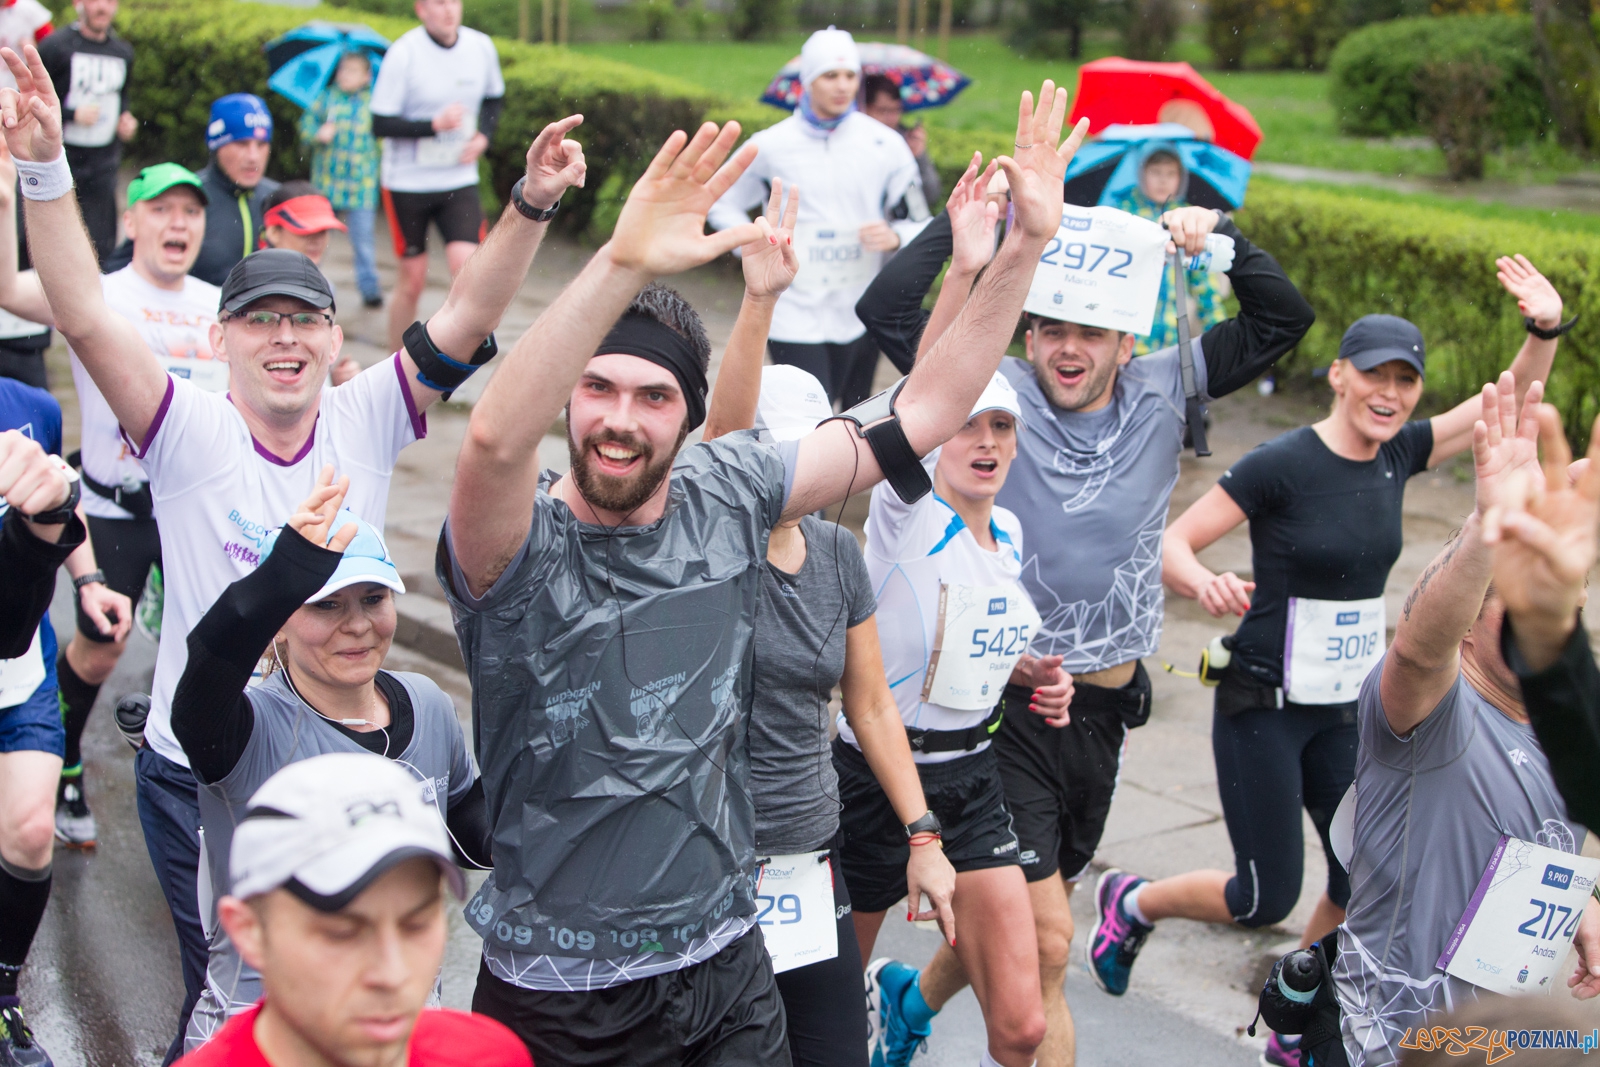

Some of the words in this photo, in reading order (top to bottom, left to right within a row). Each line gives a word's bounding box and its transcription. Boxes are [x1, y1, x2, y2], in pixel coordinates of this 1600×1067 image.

[1040, 237, 1133, 279] 2972
[1064, 273, 1098, 287] Marcin
[228, 509, 265, 535] Bupa
[969, 624, 1029, 658] 5425
[1325, 631, 1378, 661] 3018
[1517, 898, 1584, 943] 2174
[1531, 944, 1558, 961] Andrzej
